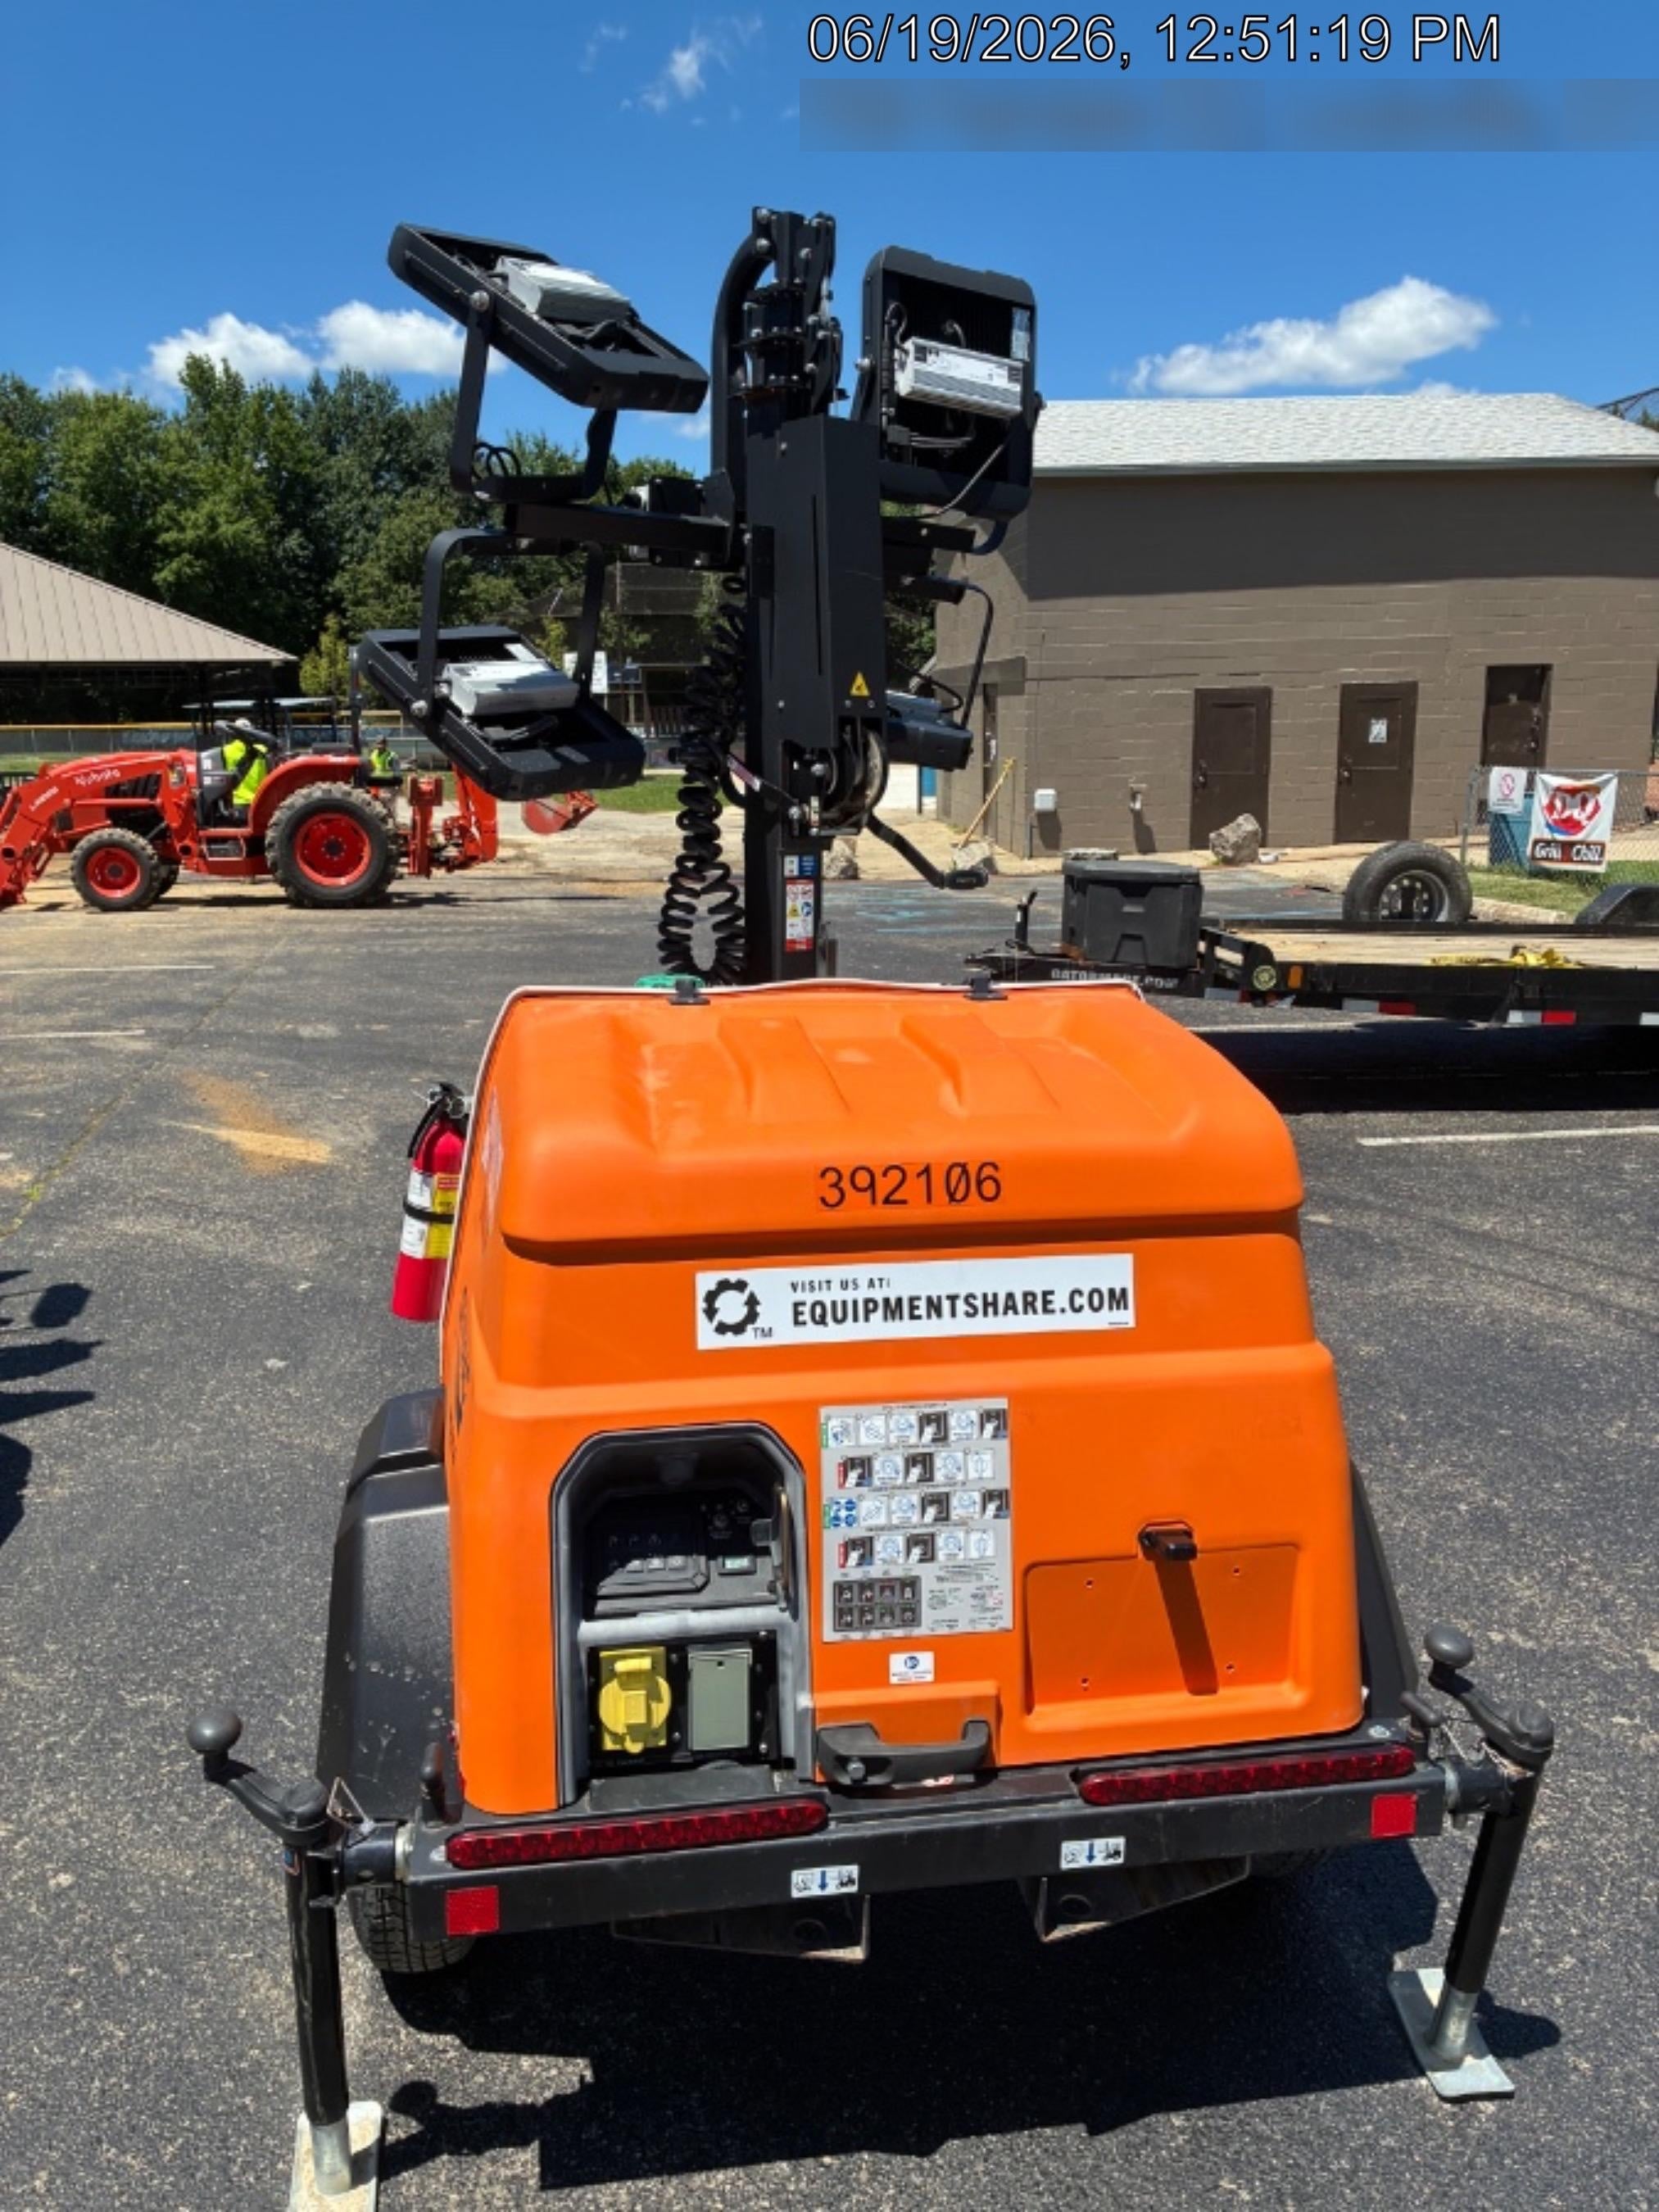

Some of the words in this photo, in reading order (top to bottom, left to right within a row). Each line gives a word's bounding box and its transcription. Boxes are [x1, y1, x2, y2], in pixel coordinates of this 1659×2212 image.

[819, 1162, 1001, 1208] 392106
[791, 1280, 832, 1294] VISIT
[840, 1278, 859, 1291] US
[791, 1287, 1129, 1328] EQUIPMENTSHARE.COM
[751, 1326, 773, 1339] TM
